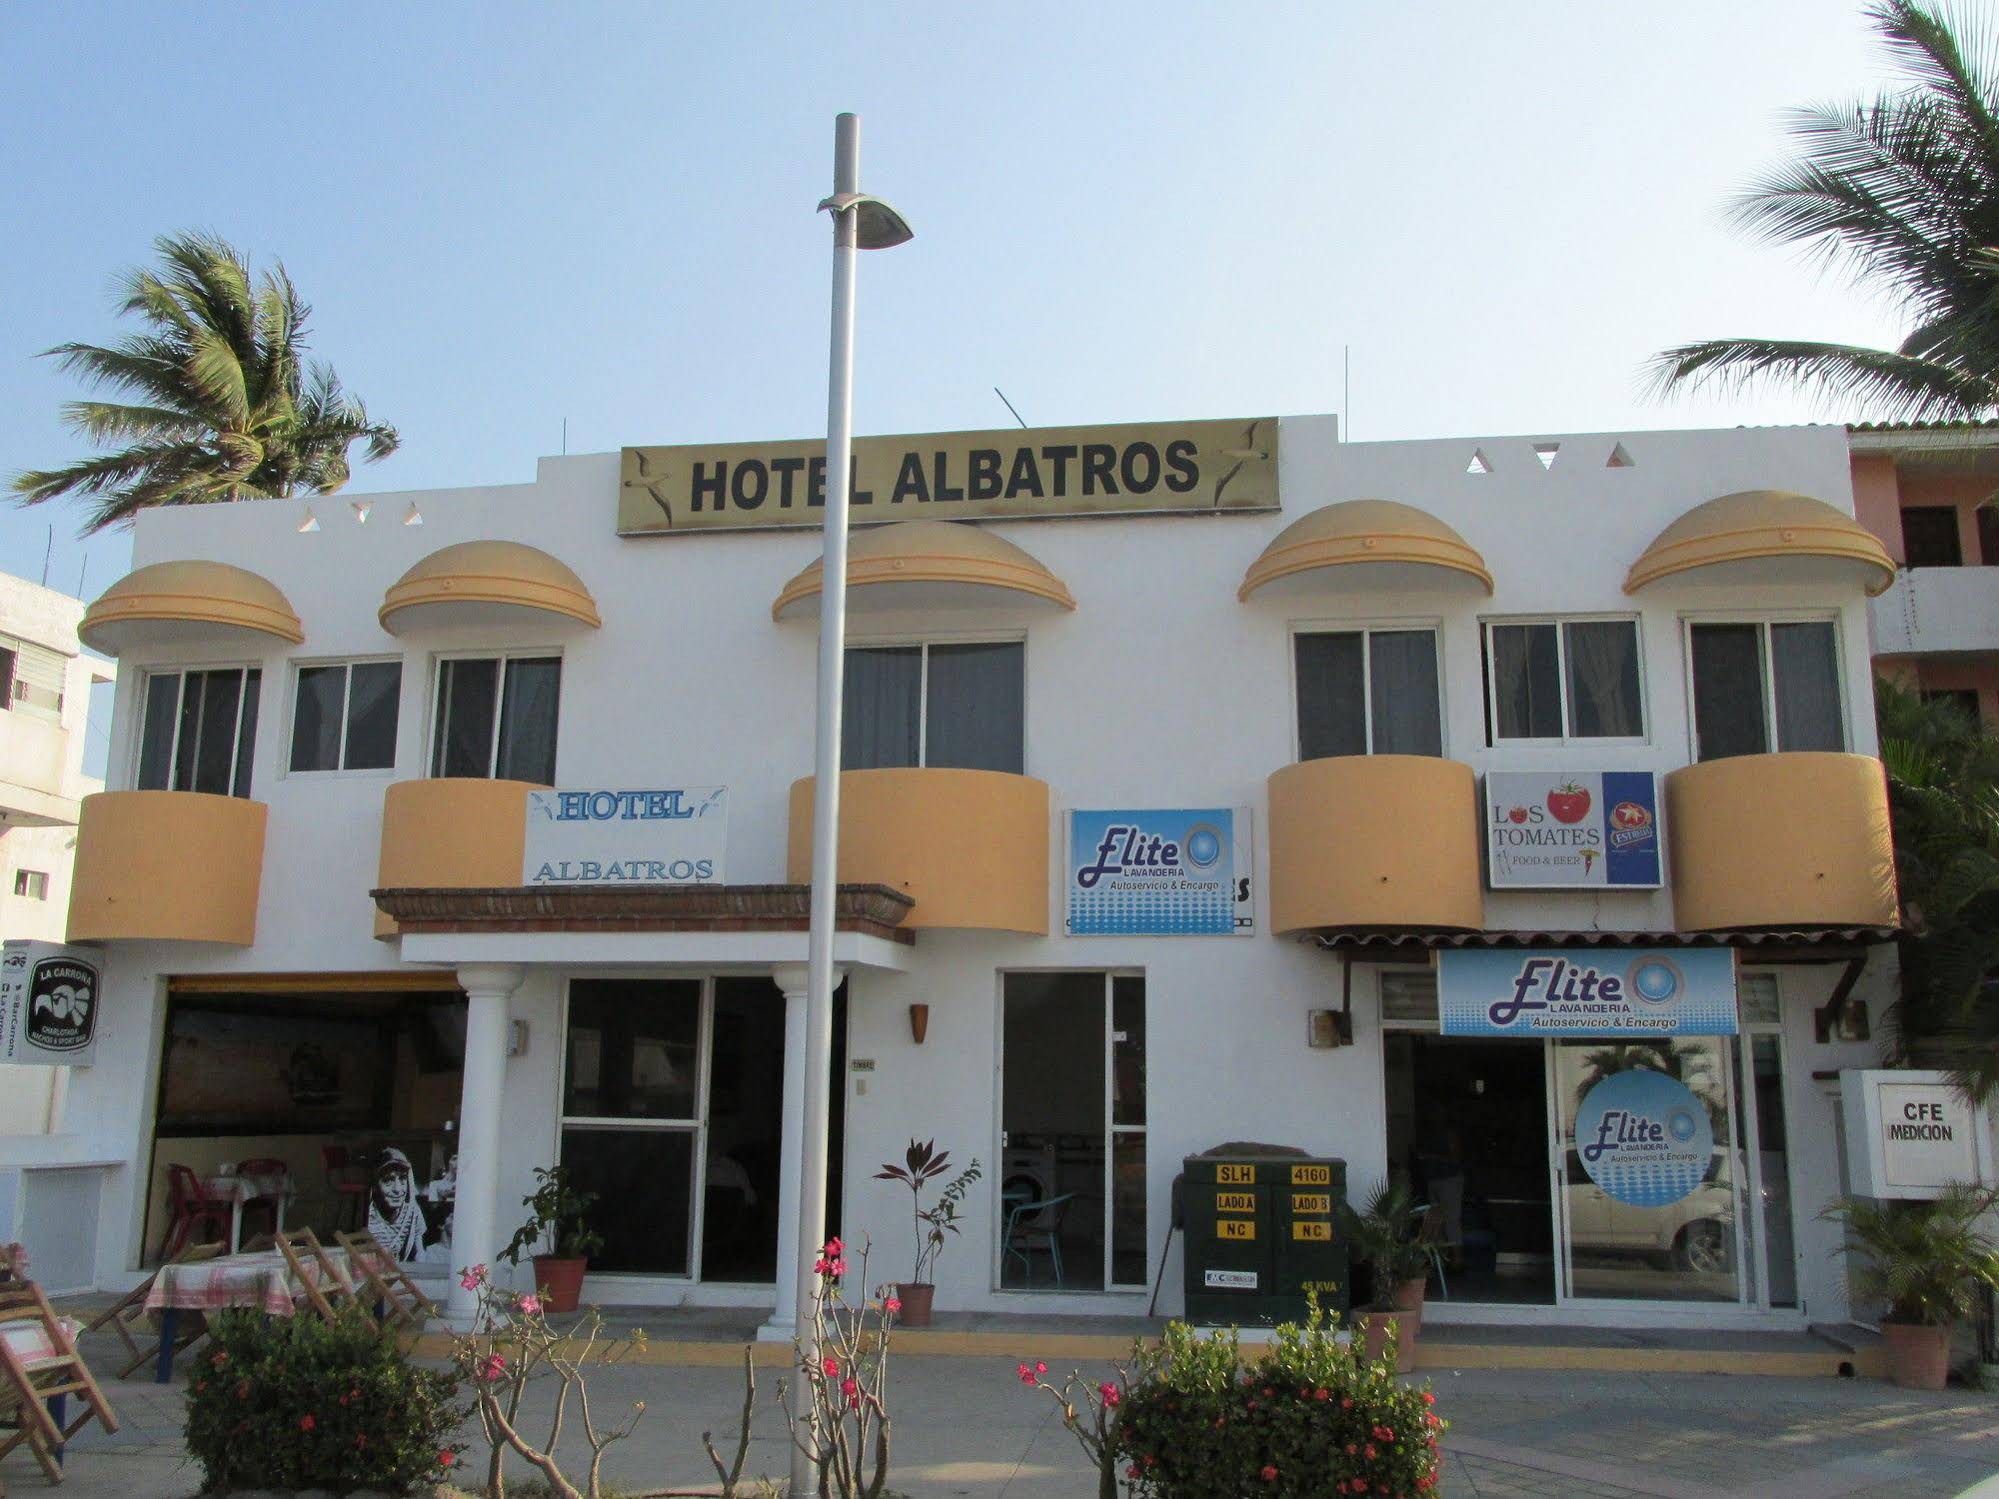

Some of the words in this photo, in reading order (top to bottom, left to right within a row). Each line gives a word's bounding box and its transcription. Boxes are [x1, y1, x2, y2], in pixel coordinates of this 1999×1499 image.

[690, 455, 873, 512] HOTEL
[890, 439, 1200, 504] ALBATROS
[557, 790, 695, 821] HOTEL
[1493, 828, 1600, 846] TOMATES
[1078, 827, 1179, 889] Elite
[1512, 855, 1541, 865] FOOD
[1542, 855, 1550, 865] &
[1553, 854, 1581, 865] BEER
[533, 859, 713, 880] ALBATROS
[1124, 868, 1184, 877] LAVANDERIA
[1110, 880, 1169, 891] Autoservicio
[1171, 880, 1178, 890] &
[1180, 880, 1219, 892] Encargo
[1489, 960, 1622, 1025] Elite
[1550, 1003, 1630, 1013] LAVANDERIA
[1532, 1017, 1609, 1028] Autoservicio
[1613, 1017, 1623, 1028] &
[1626, 1017, 1677, 1029] Encargo
[1904, 1103, 1943, 1121] CFE
[1584, 1112, 1664, 1162] Elite
[1890, 1124, 1953, 1141] MEDICION
[1620, 1143, 1670, 1152] LAVANDERIA
[1611, 1154, 1657, 1163] Autoservicio
[1667, 1153, 1698, 1162] Encargo
[1221, 1166, 1251, 1182] SLH
[1294, 1168, 1327, 1181] 4160
[1218, 1195, 1244, 1208] LADO
[1245, 1196, 1253, 1209] A
[1292, 1197, 1317, 1210] LADO
[1227, 1223, 1245, 1236] NC
[1303, 1225, 1322, 1237] NC
